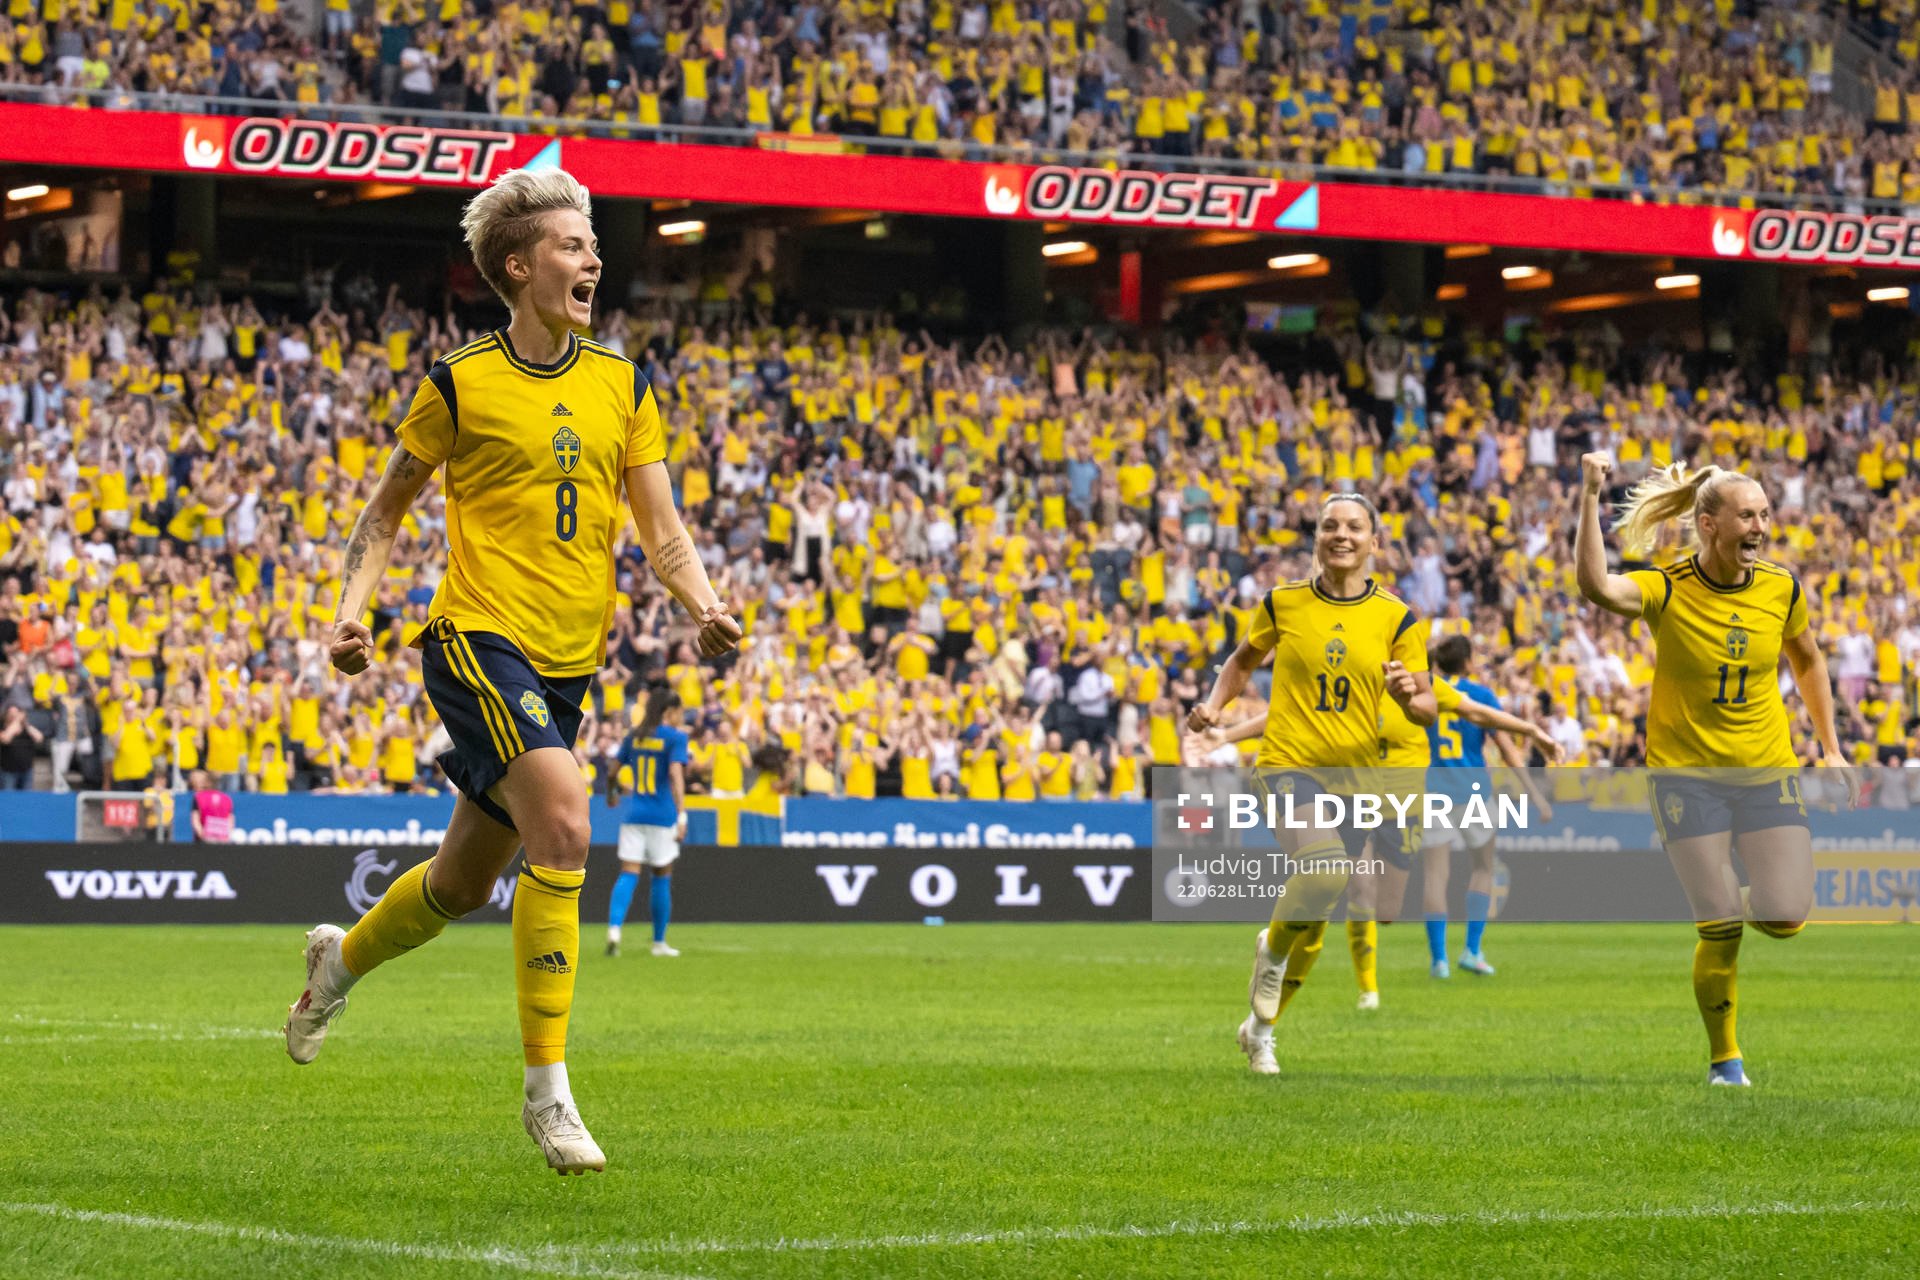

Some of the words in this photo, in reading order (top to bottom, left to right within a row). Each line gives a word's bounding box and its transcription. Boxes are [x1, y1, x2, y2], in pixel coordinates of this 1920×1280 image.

[229, 117, 515, 183] ODDSET
[1025, 165, 1277, 227] ODDSET
[556, 481, 577, 542] 8
[1315, 673, 1350, 713] 19
[1712, 664, 1749, 704] 11
[1438, 711, 1463, 759] 5
[637, 755, 656, 794] 11
[108, 805, 137, 822] 112
[44, 869, 237, 899] VOLVIA
[527, 960, 572, 974] adidas
